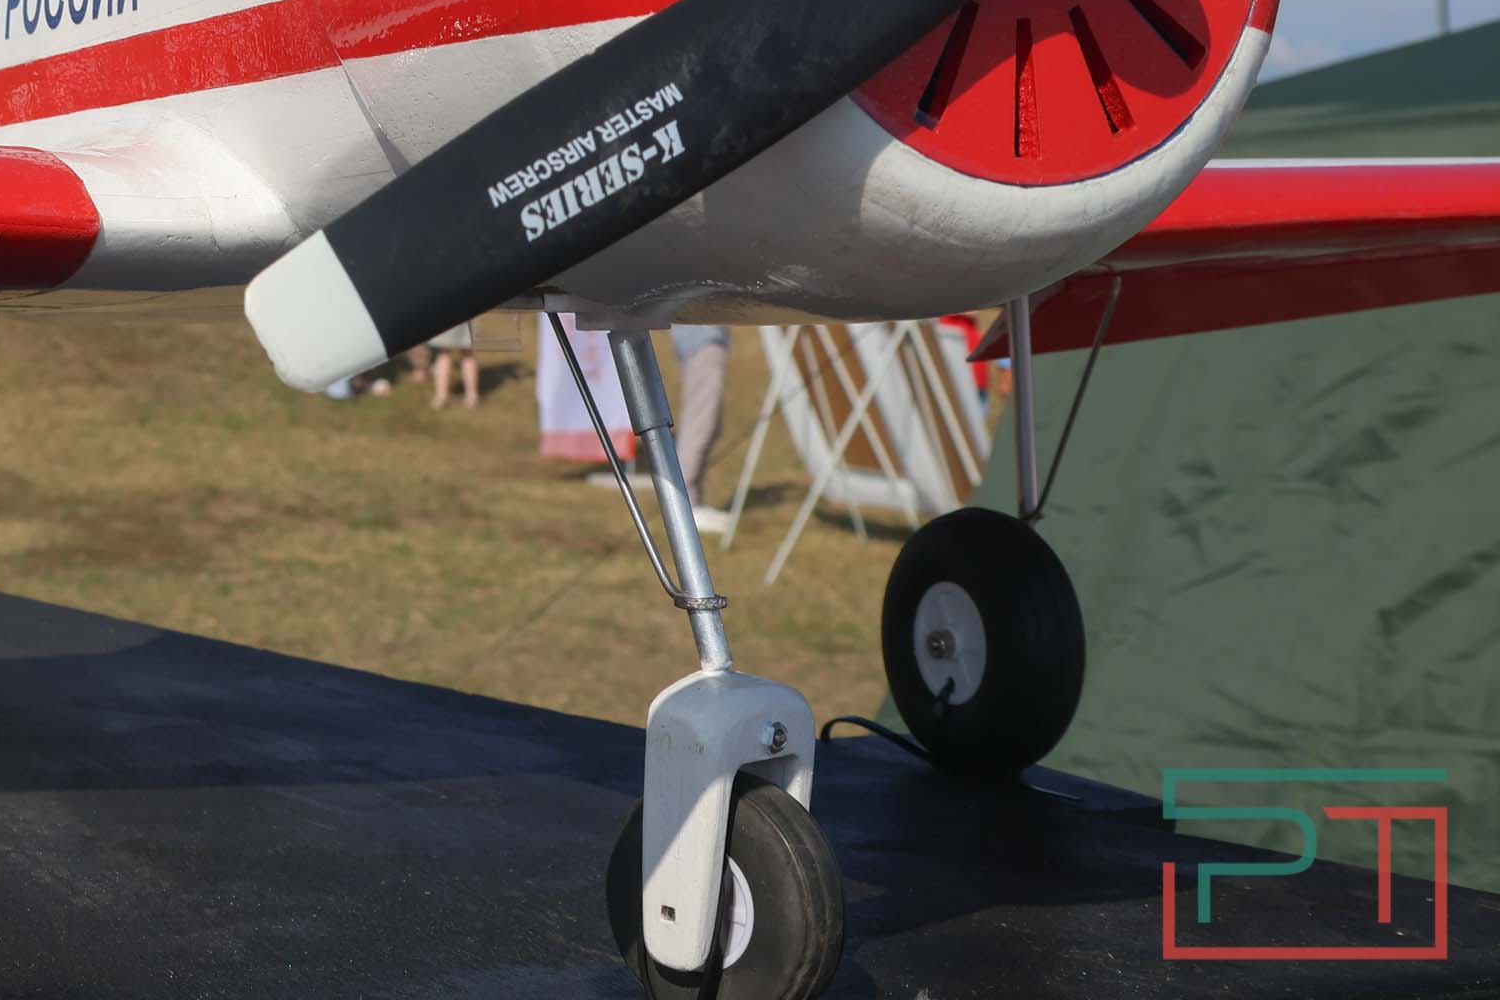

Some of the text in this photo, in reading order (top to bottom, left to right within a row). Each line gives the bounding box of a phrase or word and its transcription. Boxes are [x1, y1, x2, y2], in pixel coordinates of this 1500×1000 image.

[487, 82, 684, 209] MASTER AIRSCREW
[520, 119, 686, 243] K-SERIES
